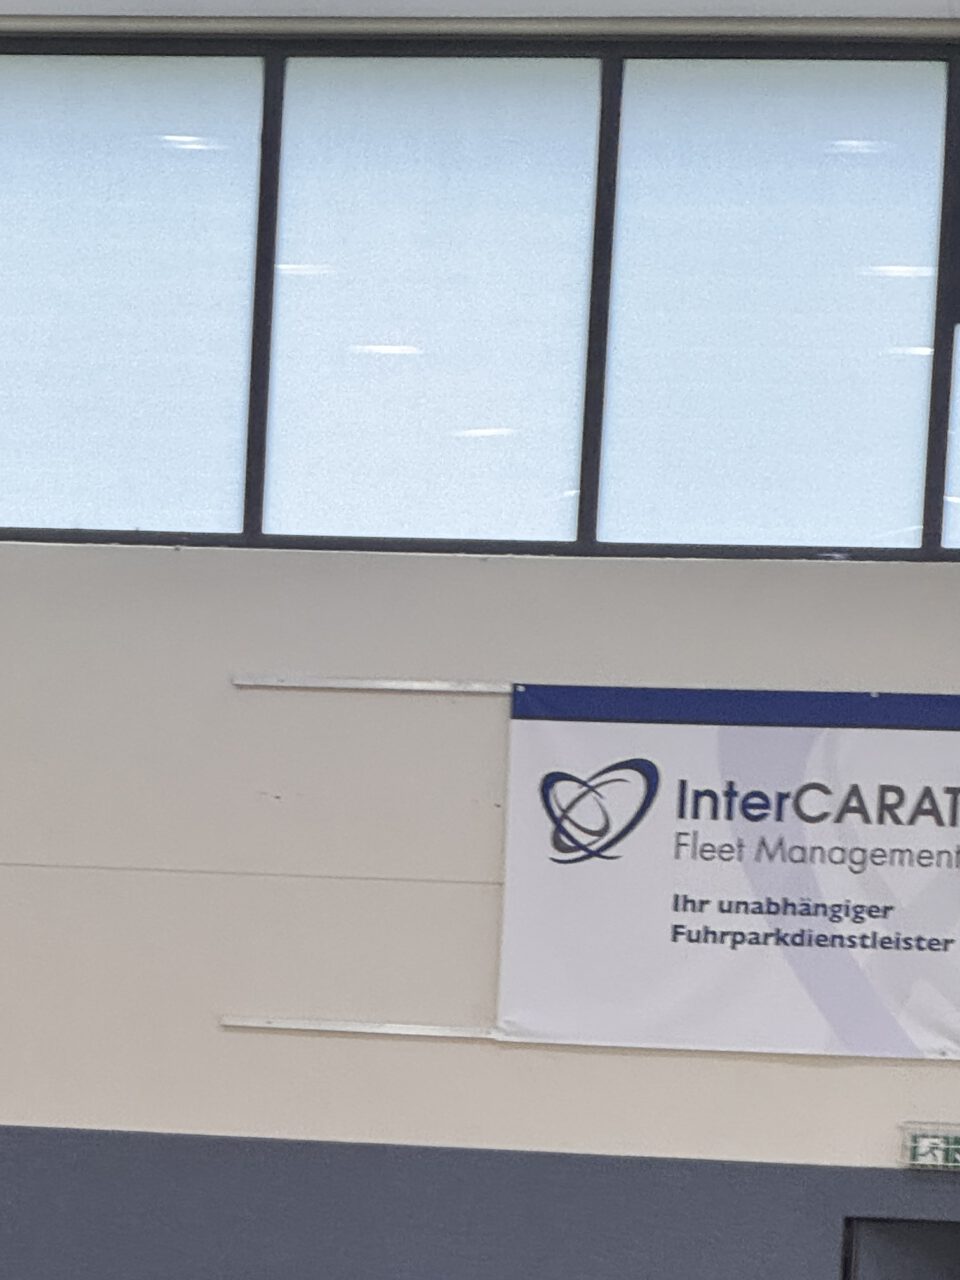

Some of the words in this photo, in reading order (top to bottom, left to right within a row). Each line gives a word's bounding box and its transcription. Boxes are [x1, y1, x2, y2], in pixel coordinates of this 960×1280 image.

[677, 779, 960, 828] InterCARAT
[674, 830, 745, 862] Fleet
[755, 837, 960, 875] Management
[672, 894, 711, 913] Ihr
[718, 897, 895, 924] unabhängiger
[671, 924, 956, 952] Fuhrparkdienstleister
